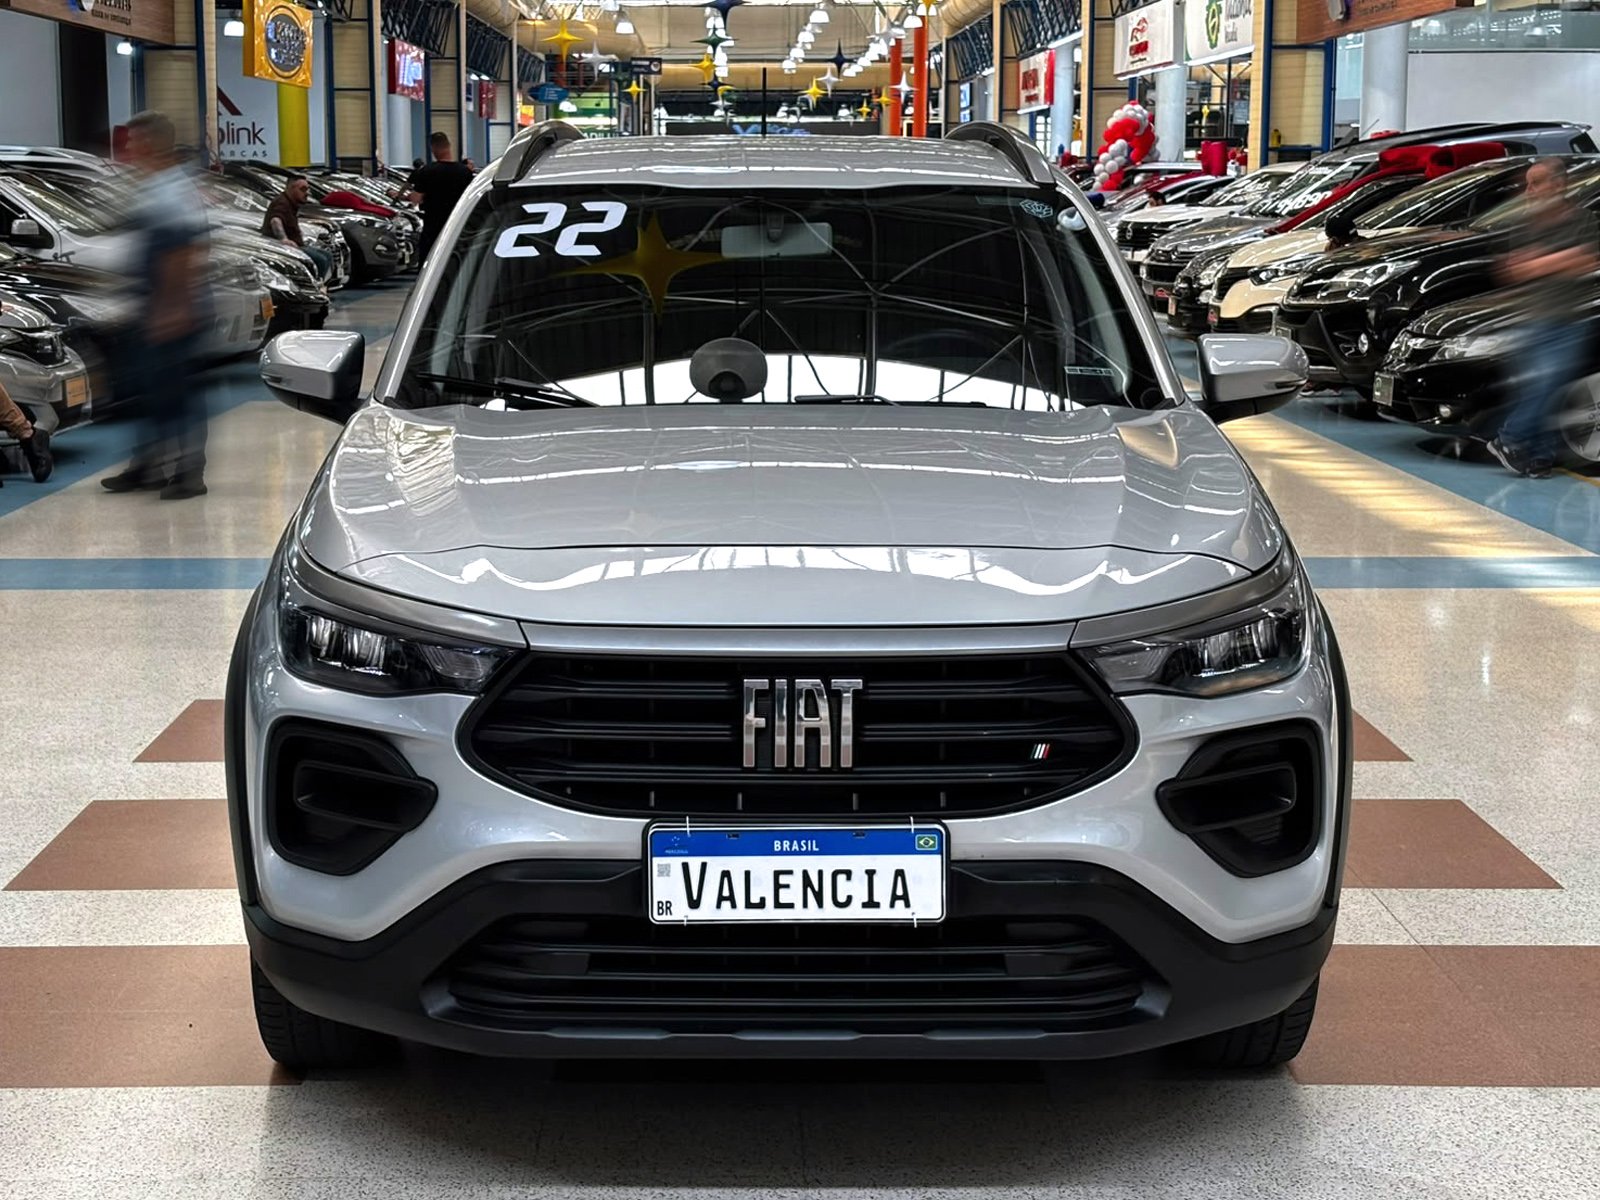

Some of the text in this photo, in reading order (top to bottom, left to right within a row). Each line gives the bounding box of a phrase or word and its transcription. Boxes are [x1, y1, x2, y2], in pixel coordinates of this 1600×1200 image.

[494, 201, 628, 258] 22
[743, 678, 864, 769] FIAT
[773, 840, 820, 852] BRASIL
[657, 900, 673, 916] BR
[681, 861, 911, 910] VALENCIA
